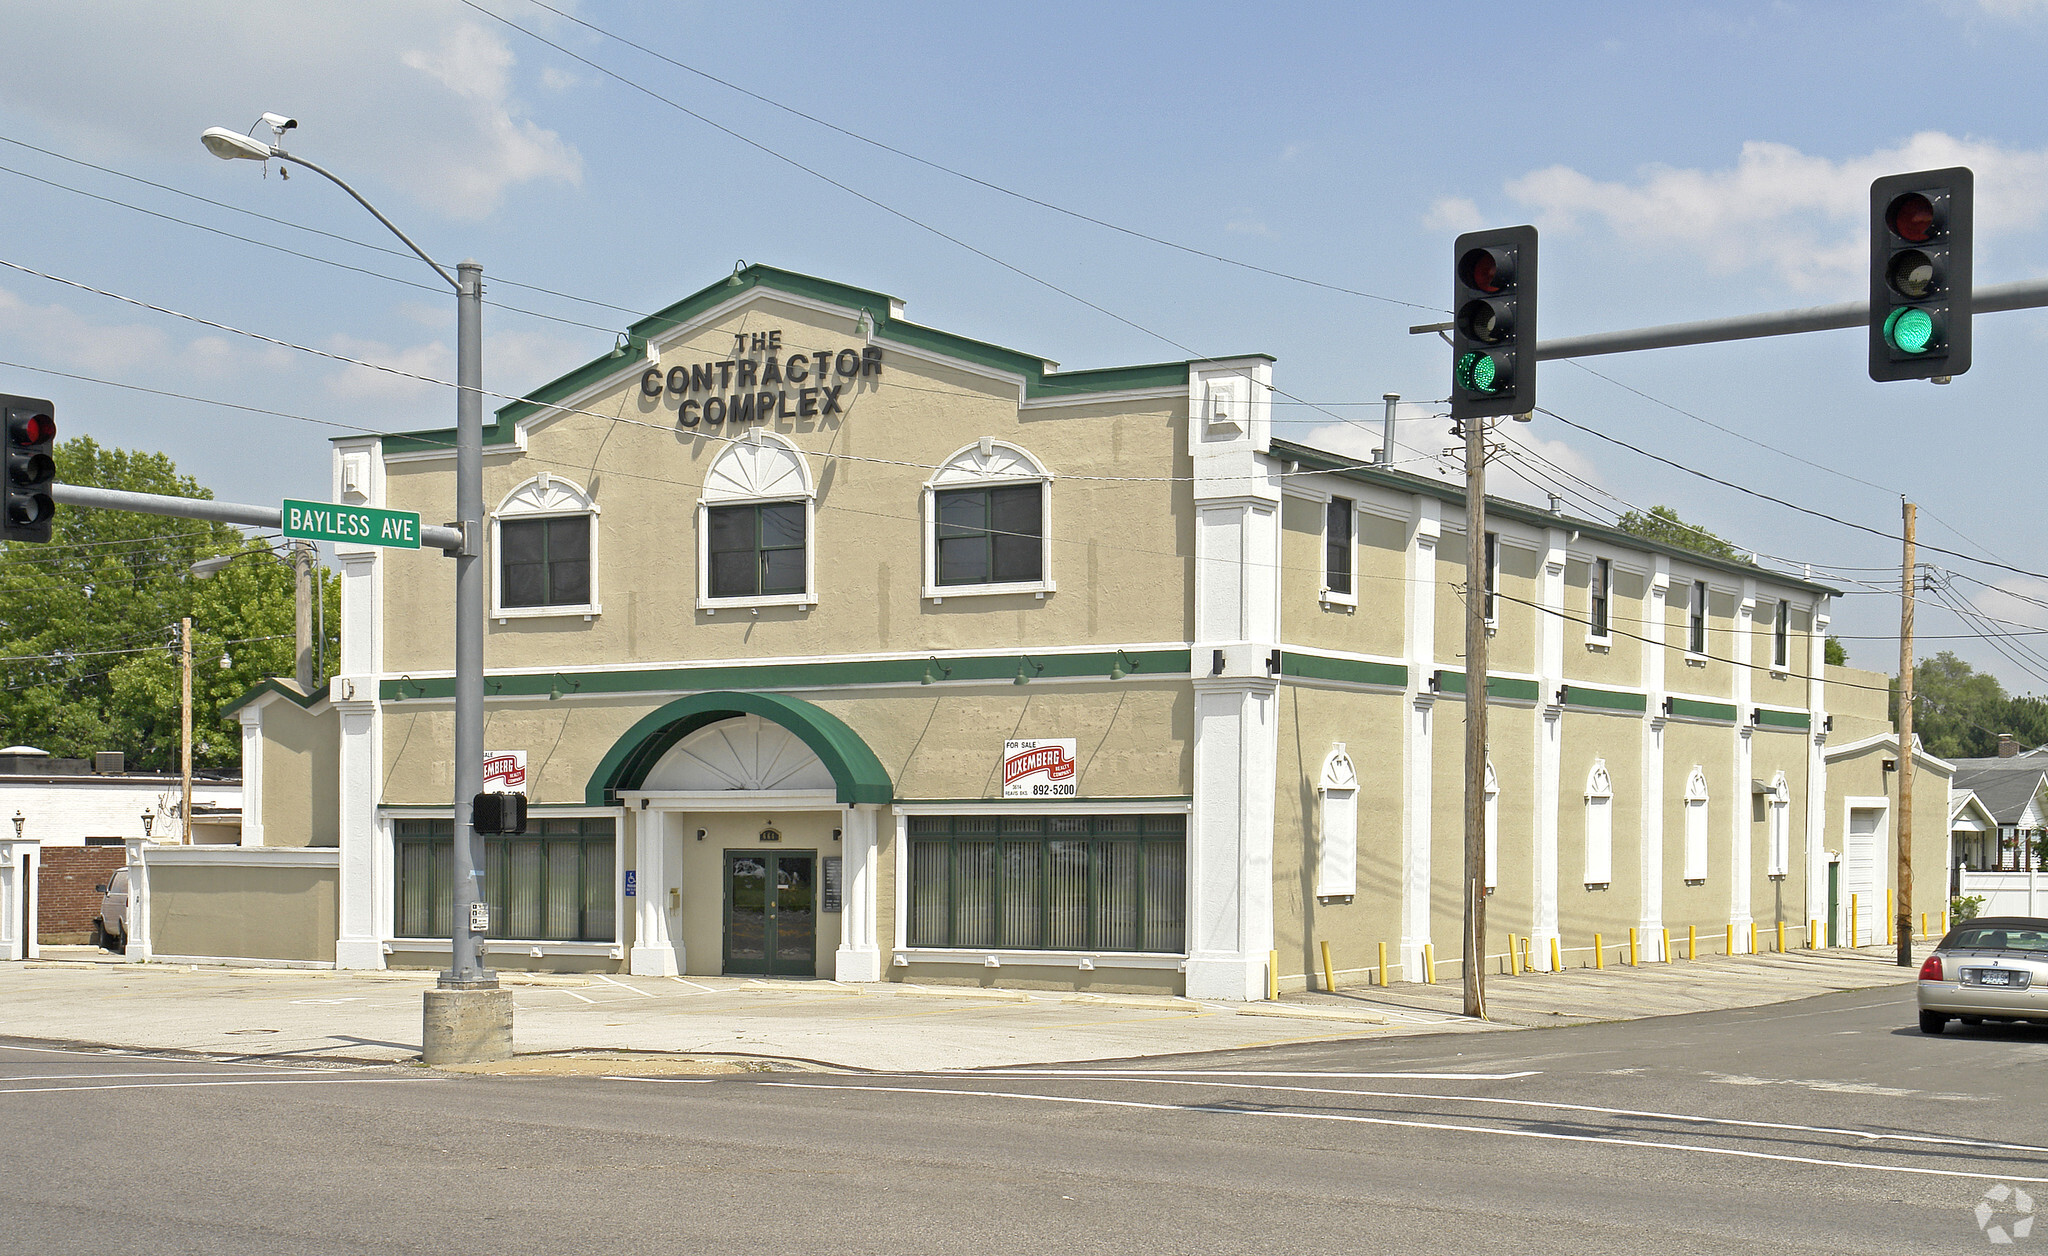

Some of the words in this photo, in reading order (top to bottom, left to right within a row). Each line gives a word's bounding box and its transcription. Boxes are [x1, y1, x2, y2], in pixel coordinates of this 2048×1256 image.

[734, 329, 782, 353] THE
[641, 346, 883, 397] CONTRACTOR
[678, 385, 842, 427] COMPLEX
[290, 508, 370, 537] BAYLESS
[381, 517, 414, 541] AVE
[1007, 751, 1059, 780] LUXEMBERG
[1033, 784, 1075, 796] 892-5200
